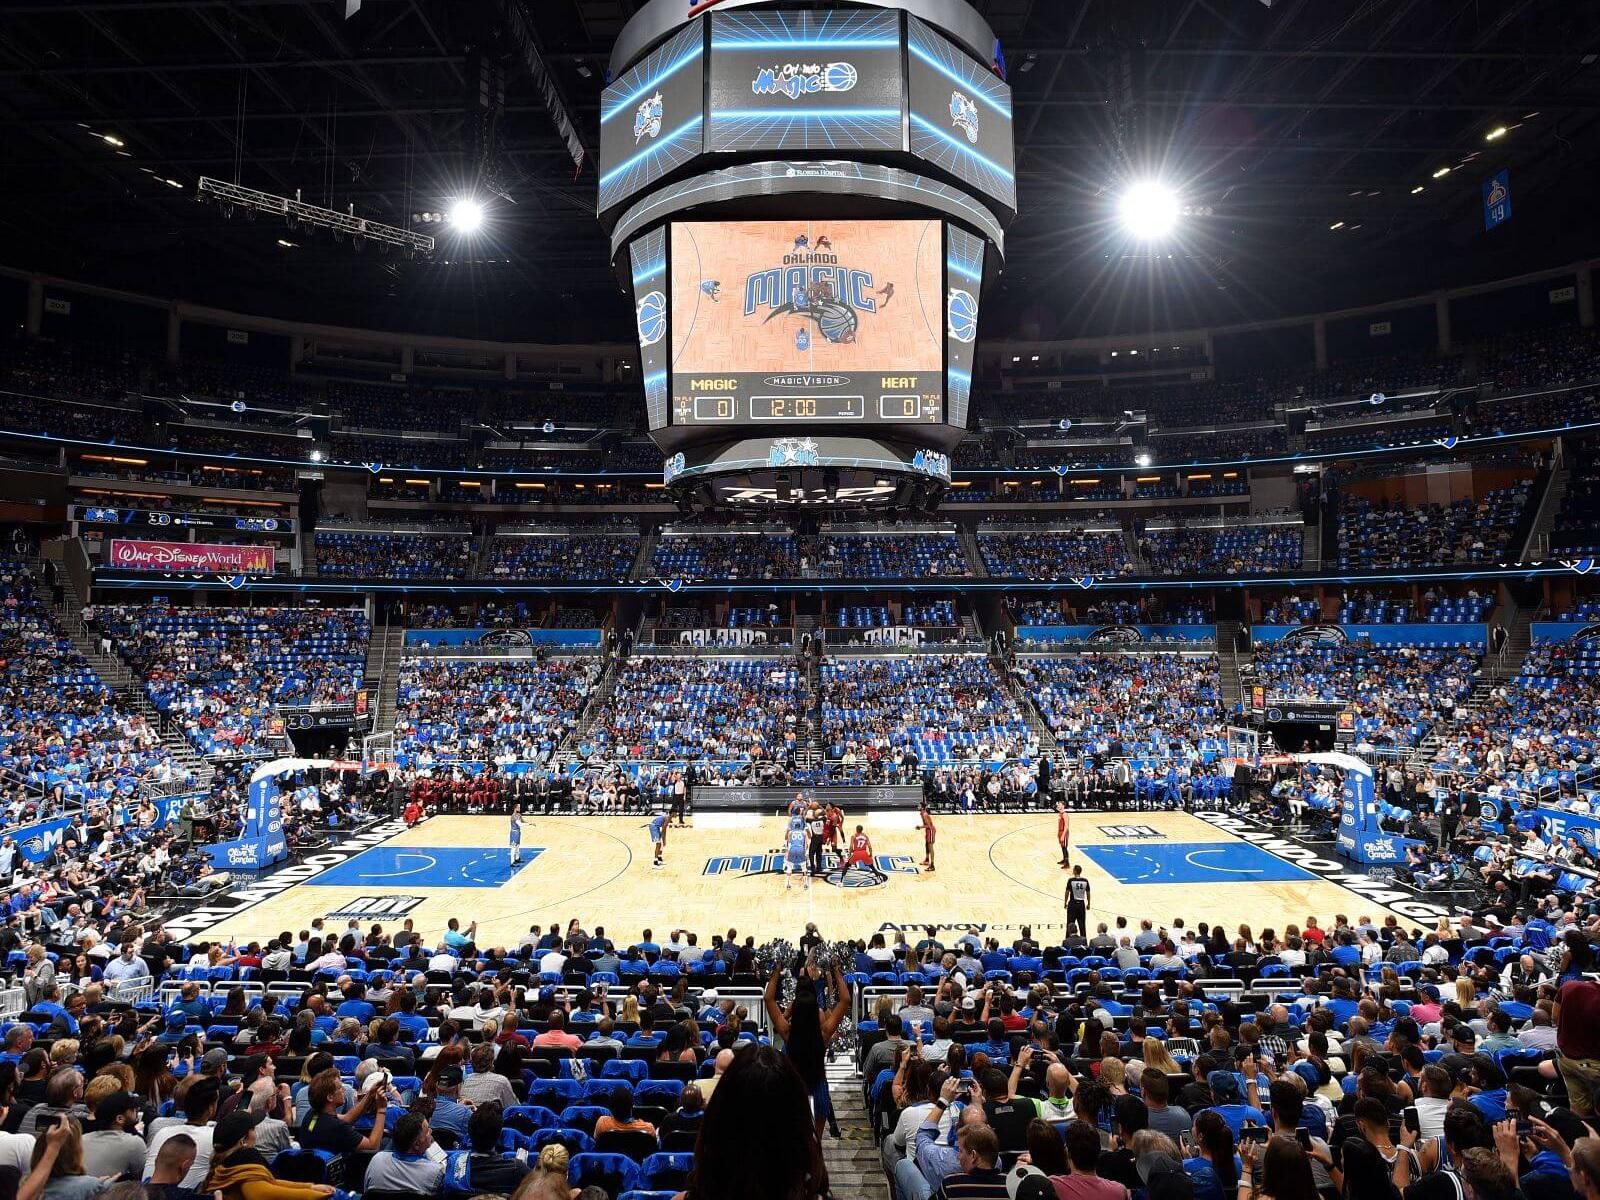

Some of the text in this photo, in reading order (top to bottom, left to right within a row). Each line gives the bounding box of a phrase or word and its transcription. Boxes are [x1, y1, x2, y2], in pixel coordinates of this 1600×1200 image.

[783, 253, 838, 265] ORLANDO
[743, 265, 877, 316] MAGIC
[690, 378, 738, 391] MAGIC
[881, 376, 918, 389] HEAT
[717, 400, 728, 417] 0
[771, 399, 817, 417] 12:00
[903, 399, 914, 416] 0
[207, 551, 242, 565] World
[1193, 811, 1344, 871] ORLANDO
[229, 855, 258, 865] Garden
[1368, 850, 1397, 860] Garden
[878, 922, 987, 933] Amway
